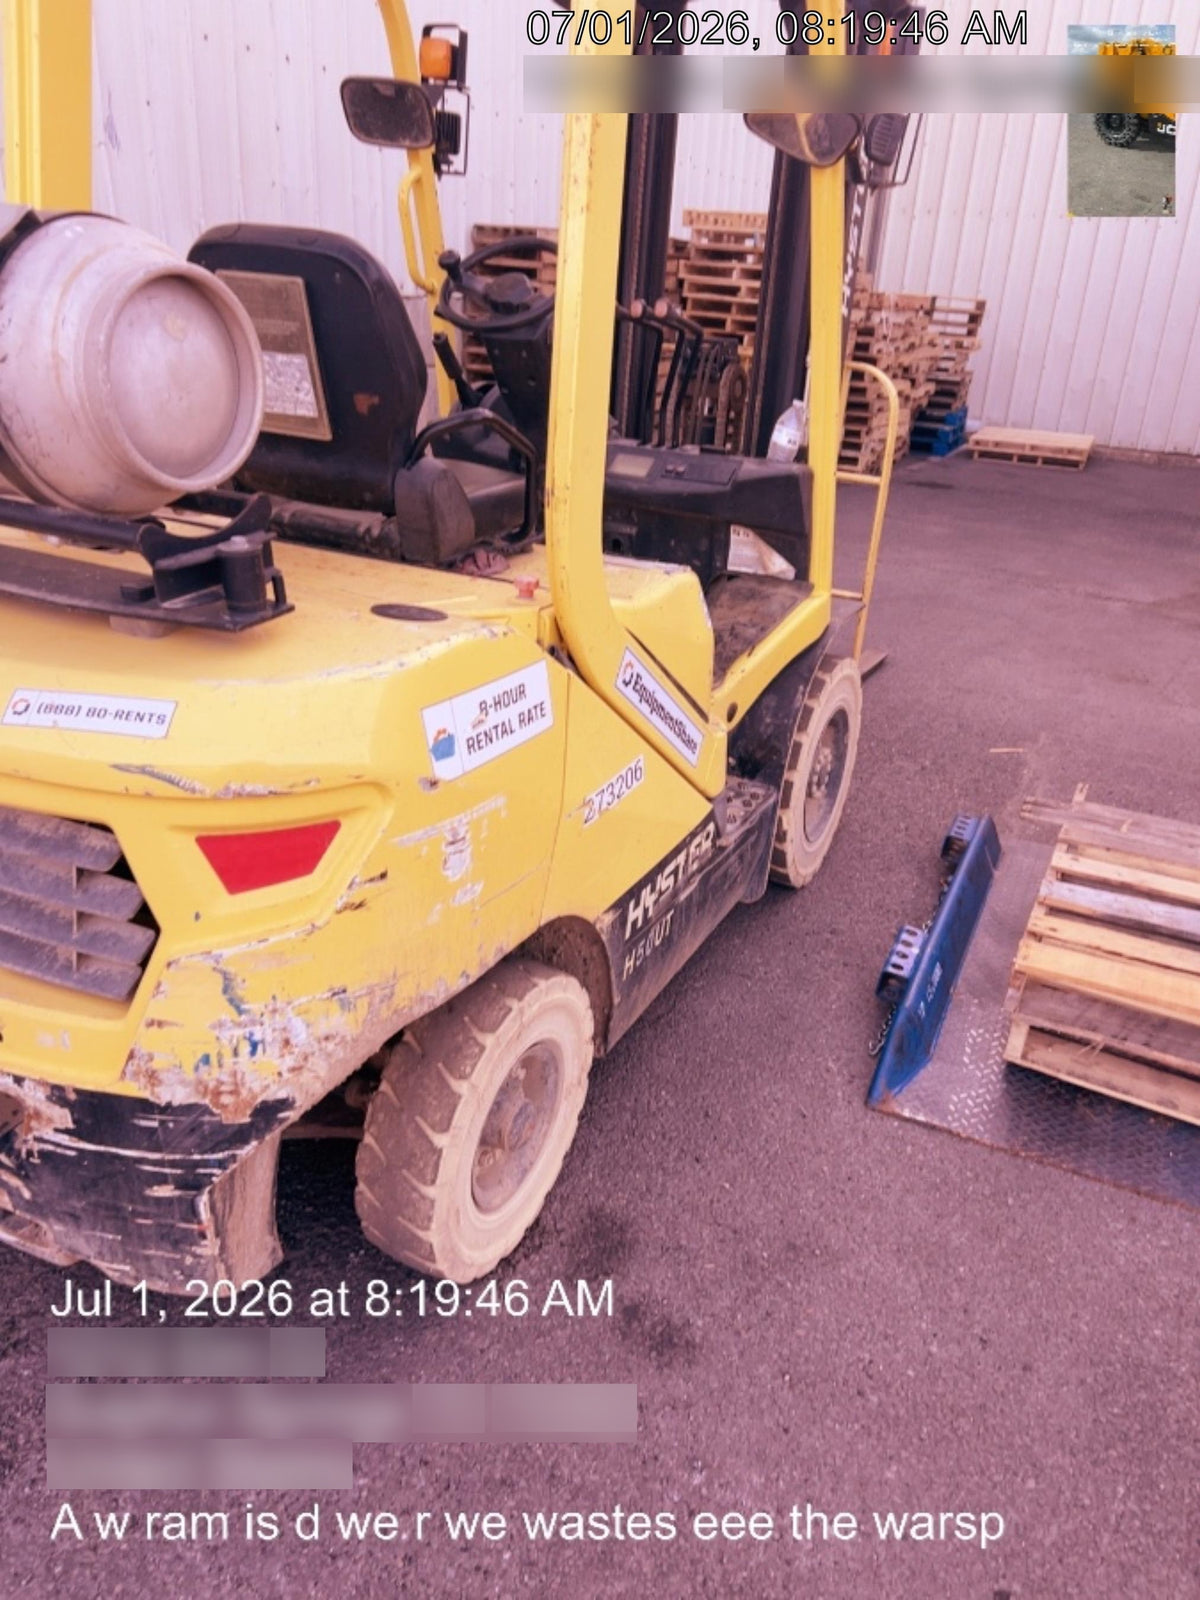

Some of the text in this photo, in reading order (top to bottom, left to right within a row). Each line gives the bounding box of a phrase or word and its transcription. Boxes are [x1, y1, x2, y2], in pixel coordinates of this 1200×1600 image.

[36, 701, 168, 726] (888) 80-RENTS
[465, 700, 547, 756] RENTAL RATE
[478, 682, 528, 719] 8-HOUR
[632, 671, 699, 755] EquipmentShare
[583, 758, 644, 824] 273206
[624, 821, 716, 941] HYSTER
